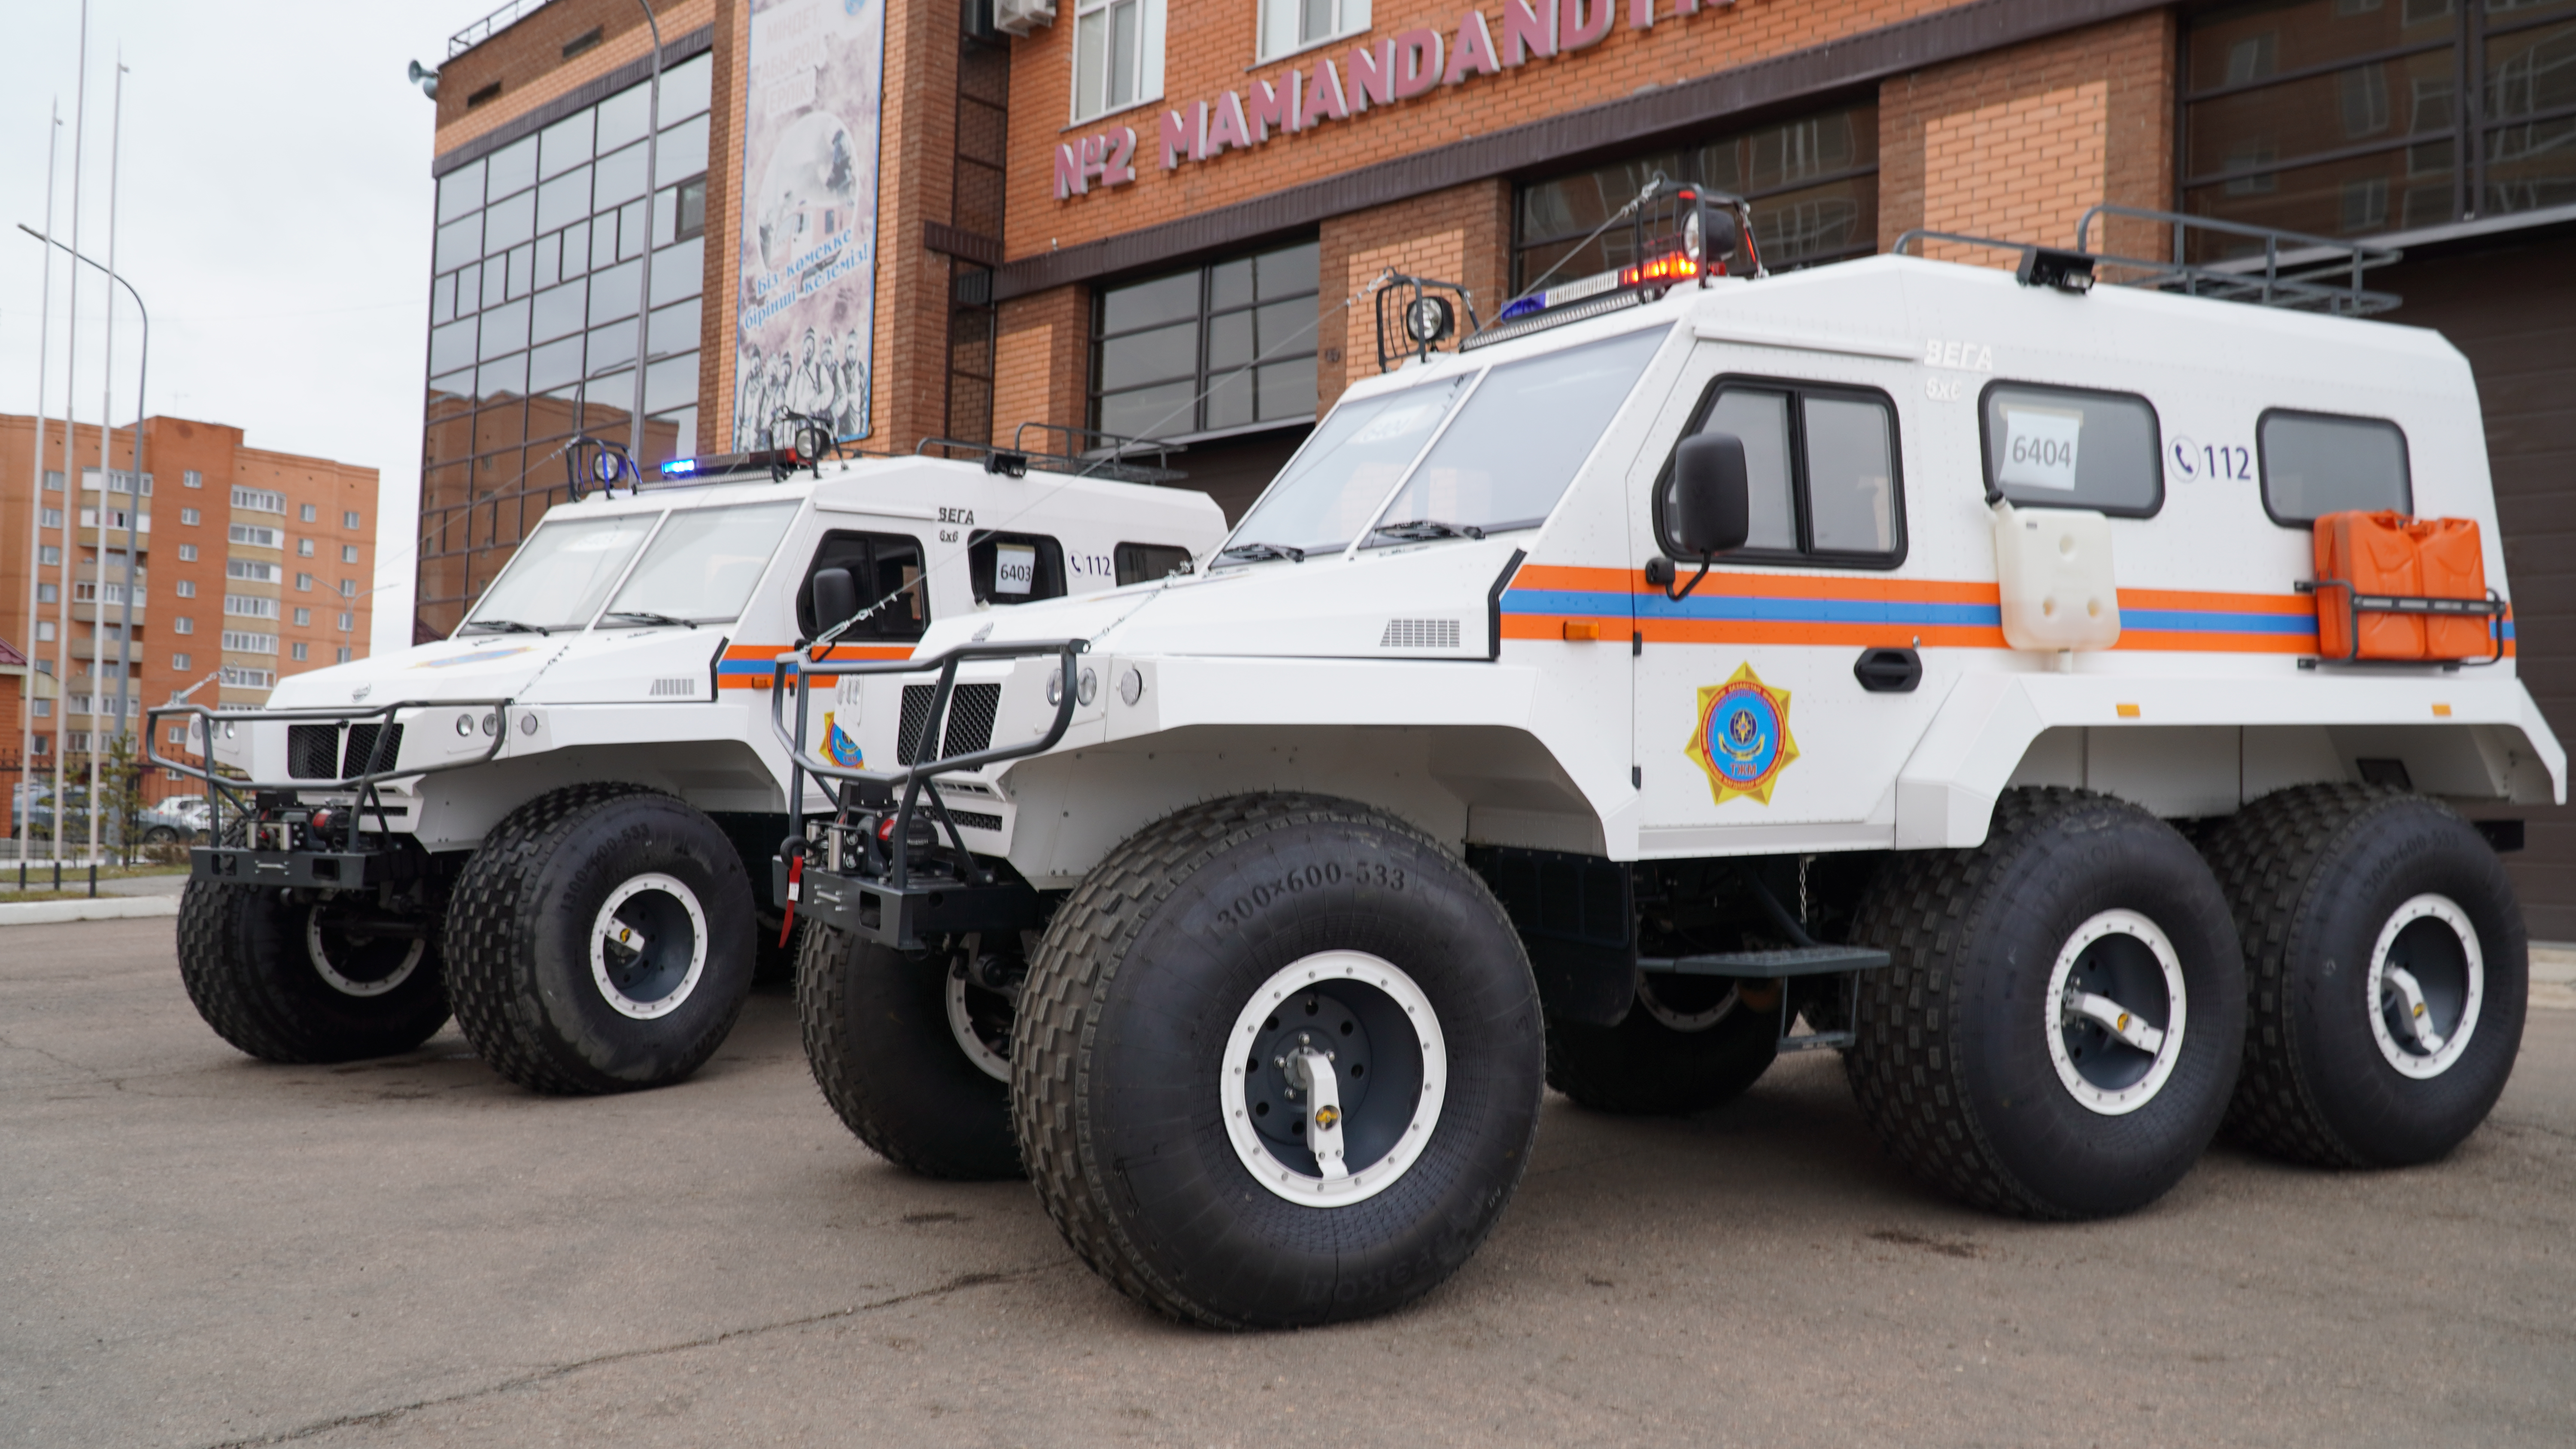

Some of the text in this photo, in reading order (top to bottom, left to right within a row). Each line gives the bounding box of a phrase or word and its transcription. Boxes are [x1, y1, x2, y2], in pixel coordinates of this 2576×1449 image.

[1159, 0, 1735, 170] MAMANDAND
[756, 228, 852, 297] Біз көмекке
[744, 243, 869, 330] бірінші келеміз!
[1924, 338, 1993, 372] ВЕГА
[2012, 434, 2072, 469] 6404
[2204, 445, 2252, 481] 112
[938, 507, 974, 525] ВЕГА
[1000, 564, 1031, 582] 6403
[1086, 556, 1111, 576] 112
[1730, 763, 1757, 776] ТЖМ
